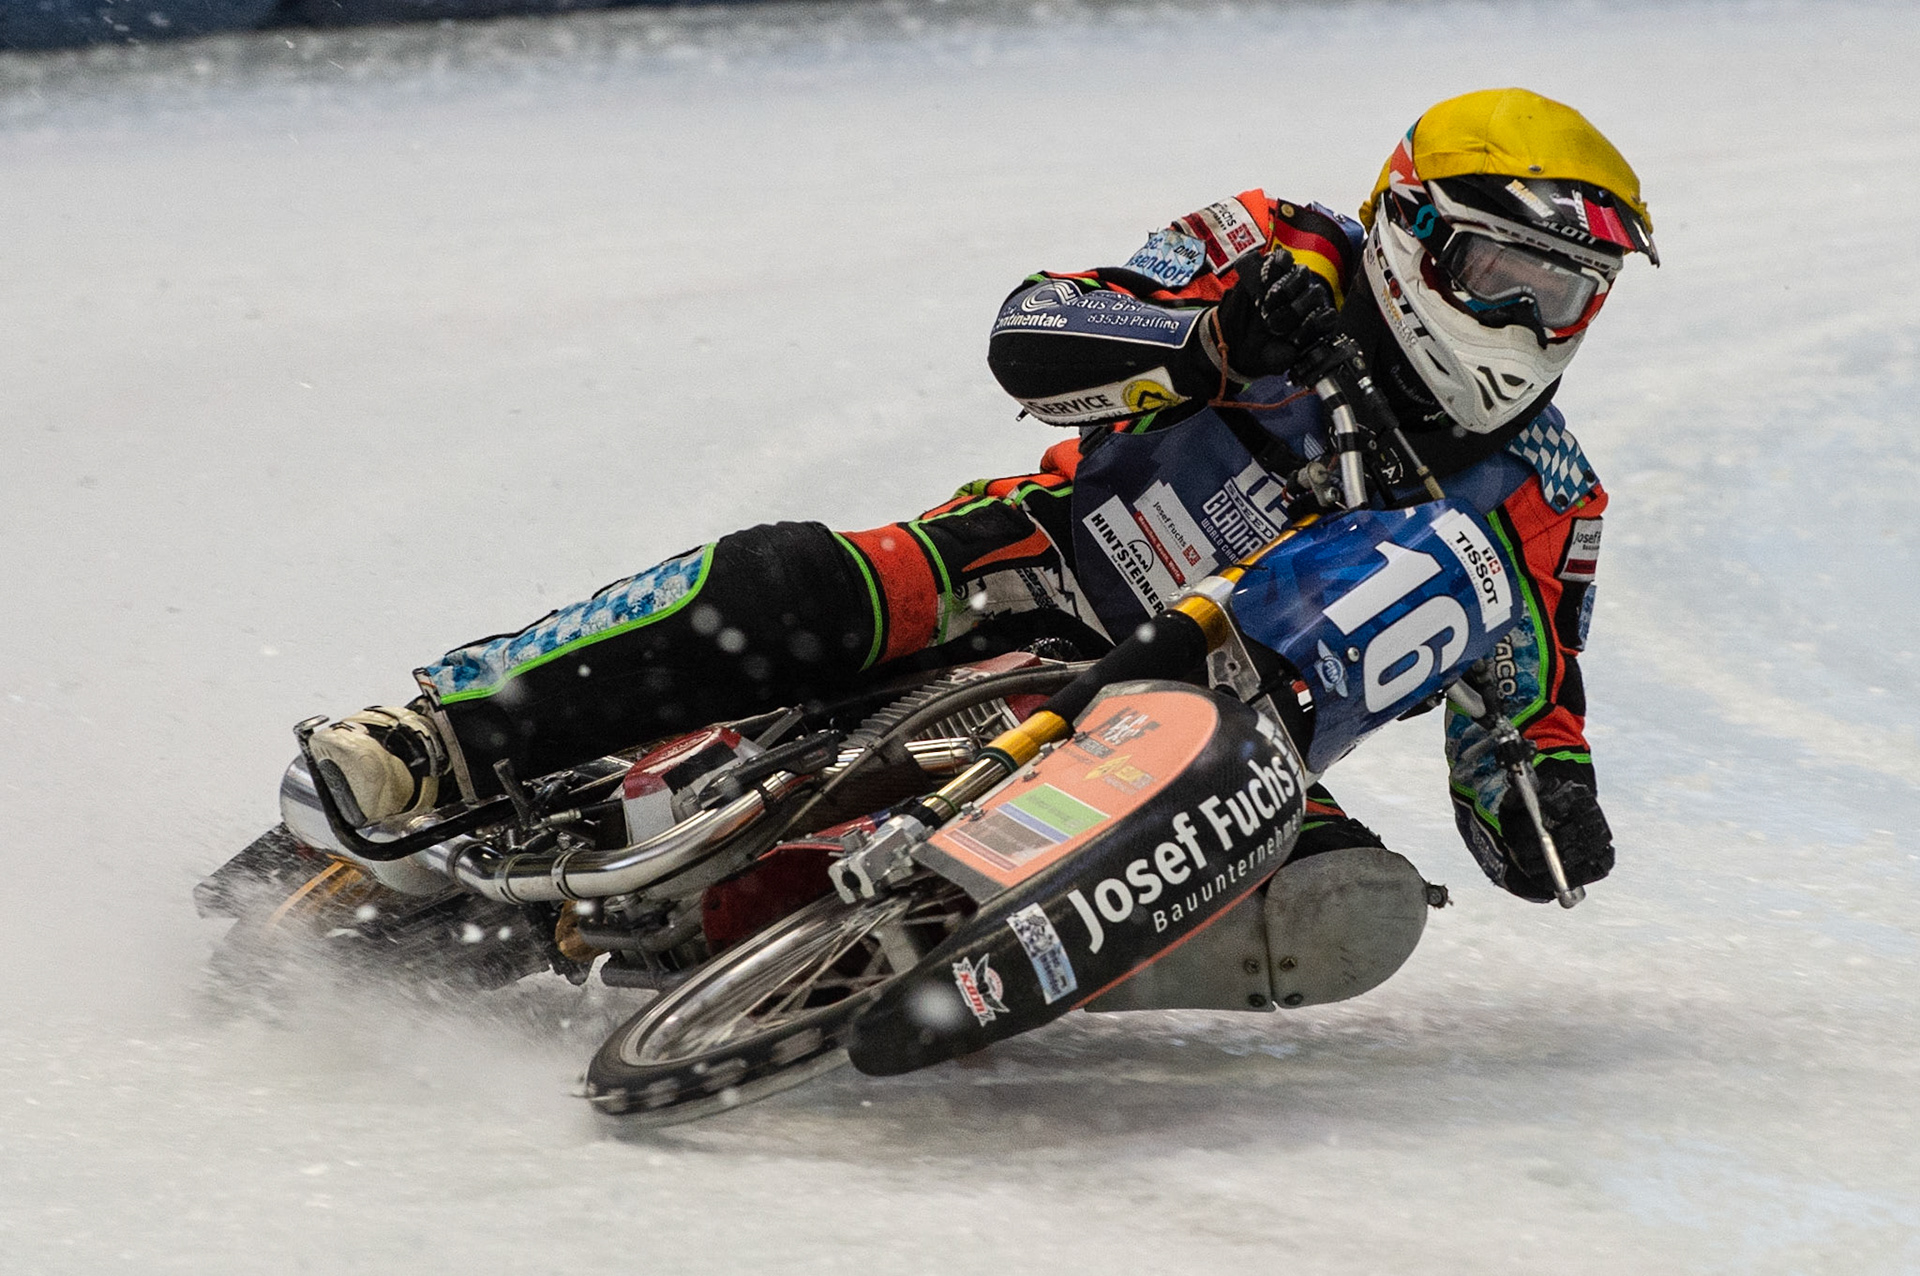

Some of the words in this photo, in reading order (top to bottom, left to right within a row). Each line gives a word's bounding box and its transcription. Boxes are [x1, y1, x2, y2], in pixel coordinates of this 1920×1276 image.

[1091, 513, 1165, 614] HINTSTEINER
[1128, 543, 1149, 571] MAN
[1456, 531, 1499, 605] TISSOT
[1322, 541, 1470, 714] 16
[1067, 811, 1208, 955] Josef
[1198, 755, 1296, 851] Fuchs
